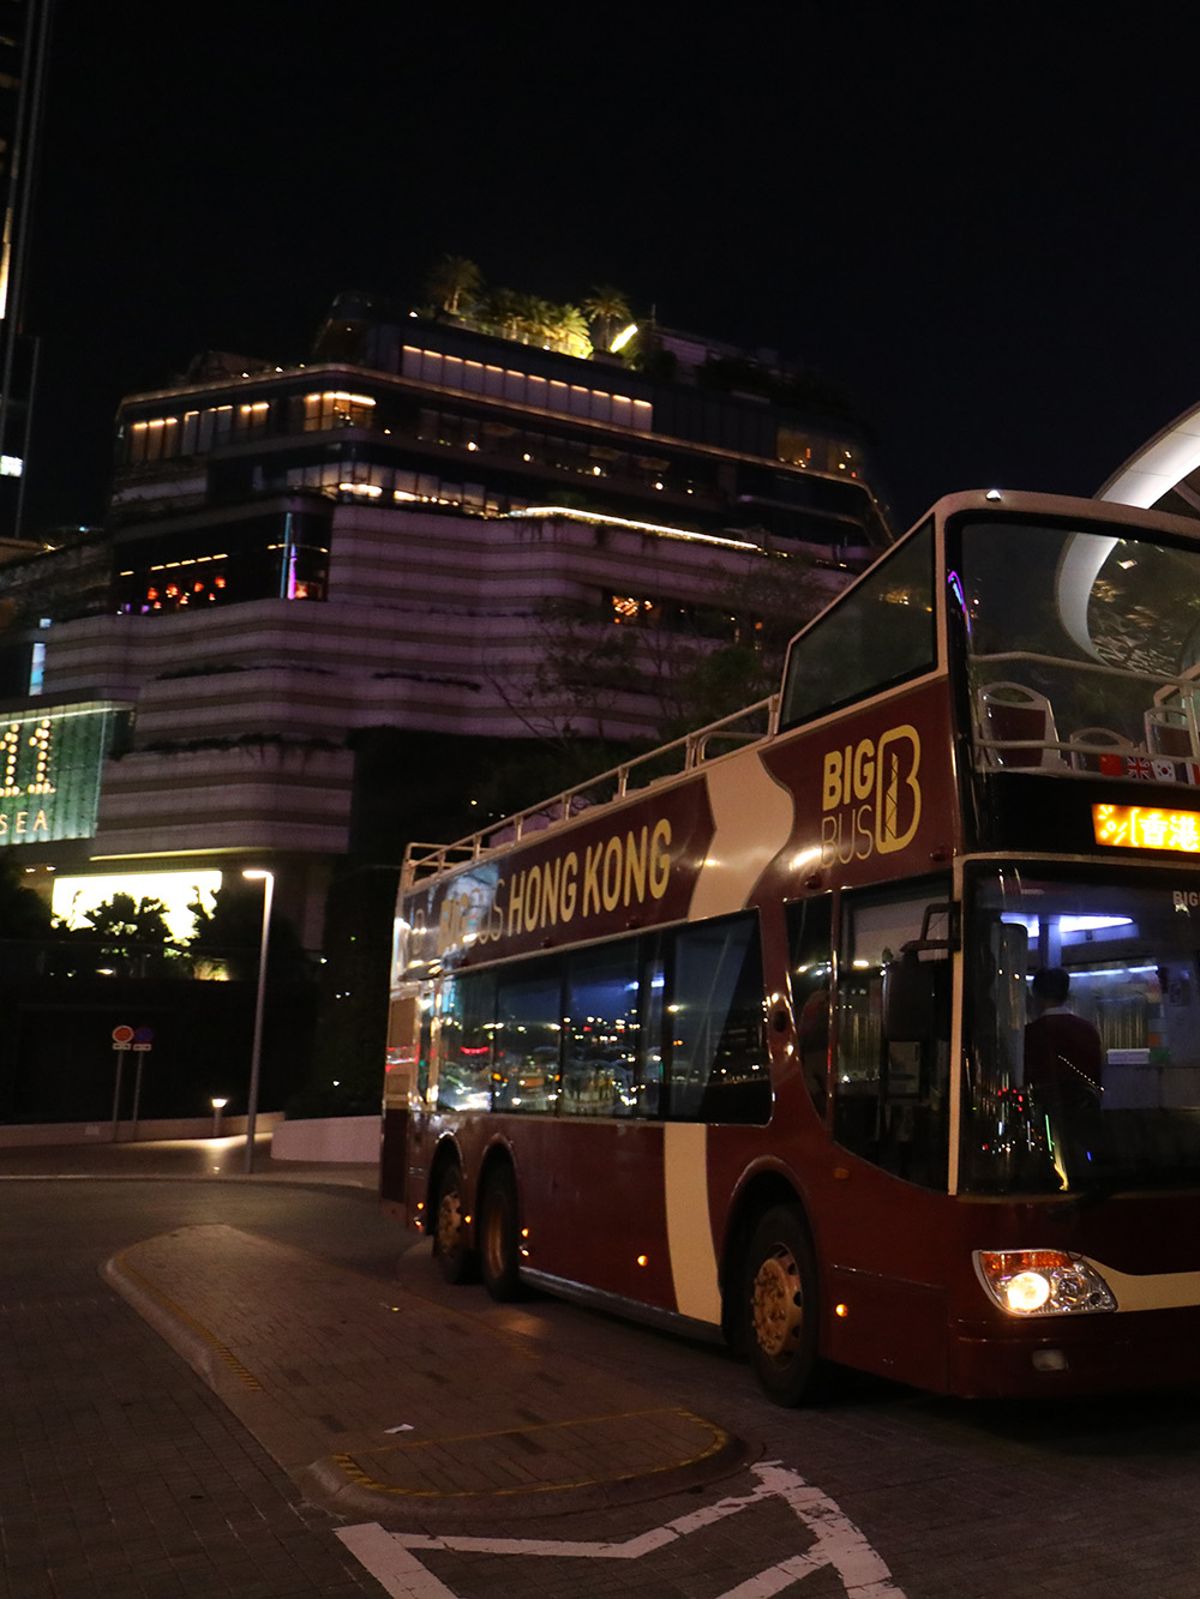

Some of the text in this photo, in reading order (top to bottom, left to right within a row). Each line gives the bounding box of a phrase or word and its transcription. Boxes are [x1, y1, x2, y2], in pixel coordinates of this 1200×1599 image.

[822, 738, 875, 812] BIG
[821, 804, 874, 868] BUS
[508, 851, 579, 938] HONG
[582, 817, 673, 918] KONG
